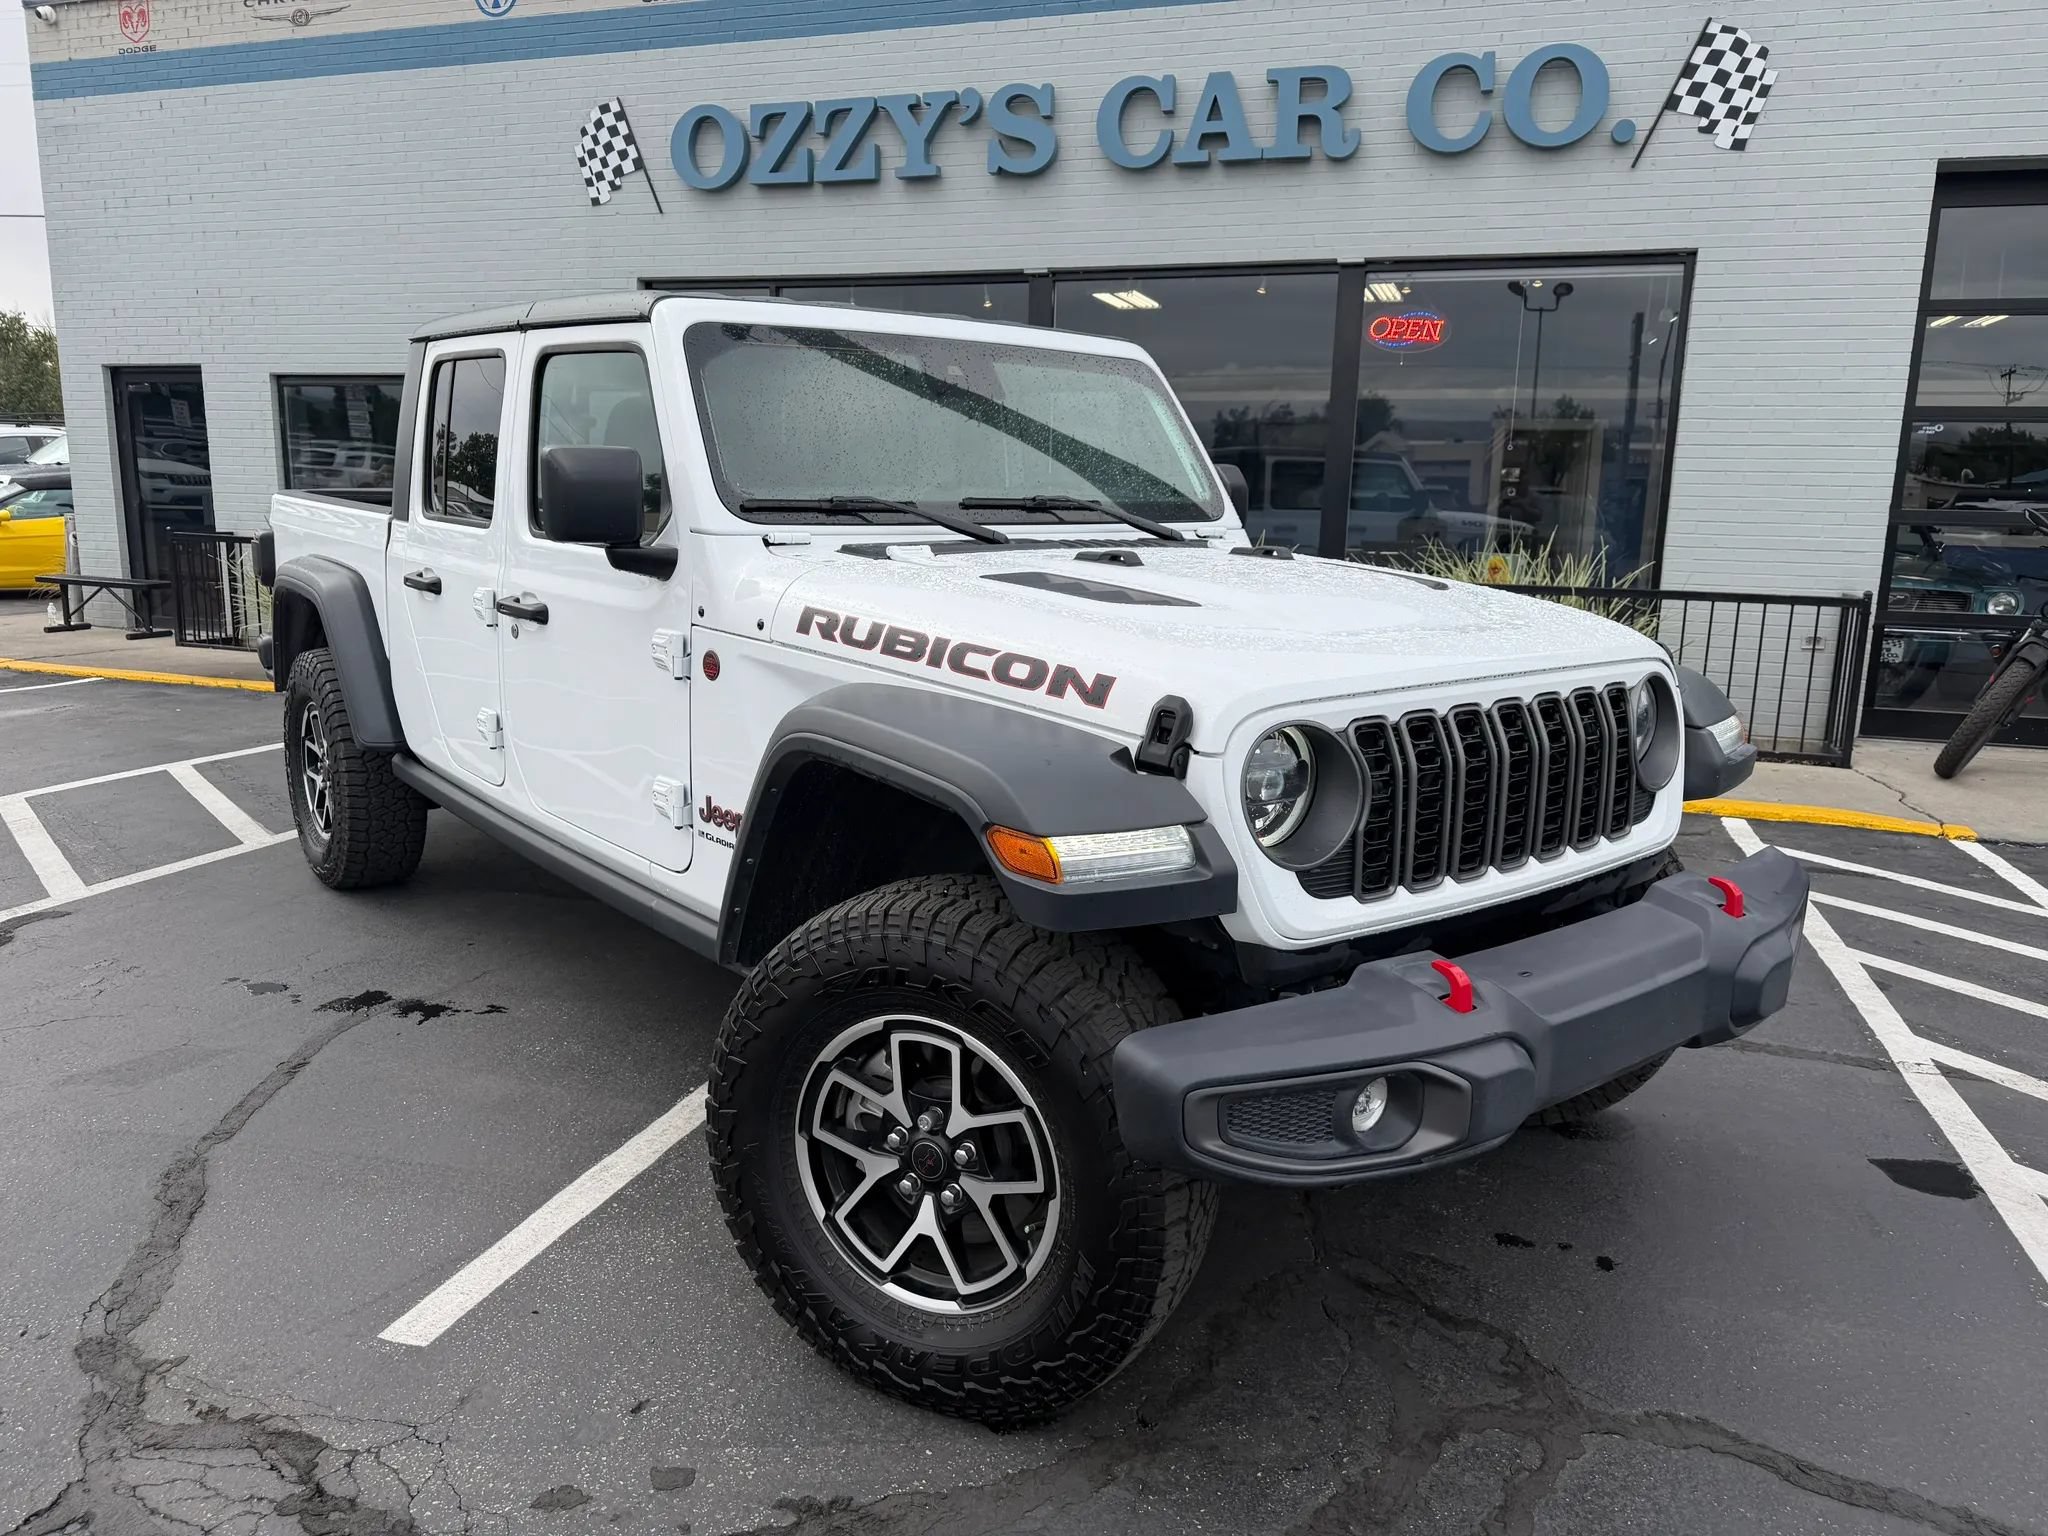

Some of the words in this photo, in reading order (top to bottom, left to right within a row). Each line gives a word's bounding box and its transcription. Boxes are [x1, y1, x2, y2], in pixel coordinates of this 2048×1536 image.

[118, 45, 157, 55] DODGE
[670, 82, 1058, 191] OZZY'S
[1096, 65, 1361, 170] CAR
[1406, 42, 1637, 154] CO.
[1369, 315, 1444, 342] OPEN
[796, 605, 1117, 710] RUBICON
[814, 966, 1050, 1069] FALKEN
[860, 1251, 1096, 1376] WILDPEAK
